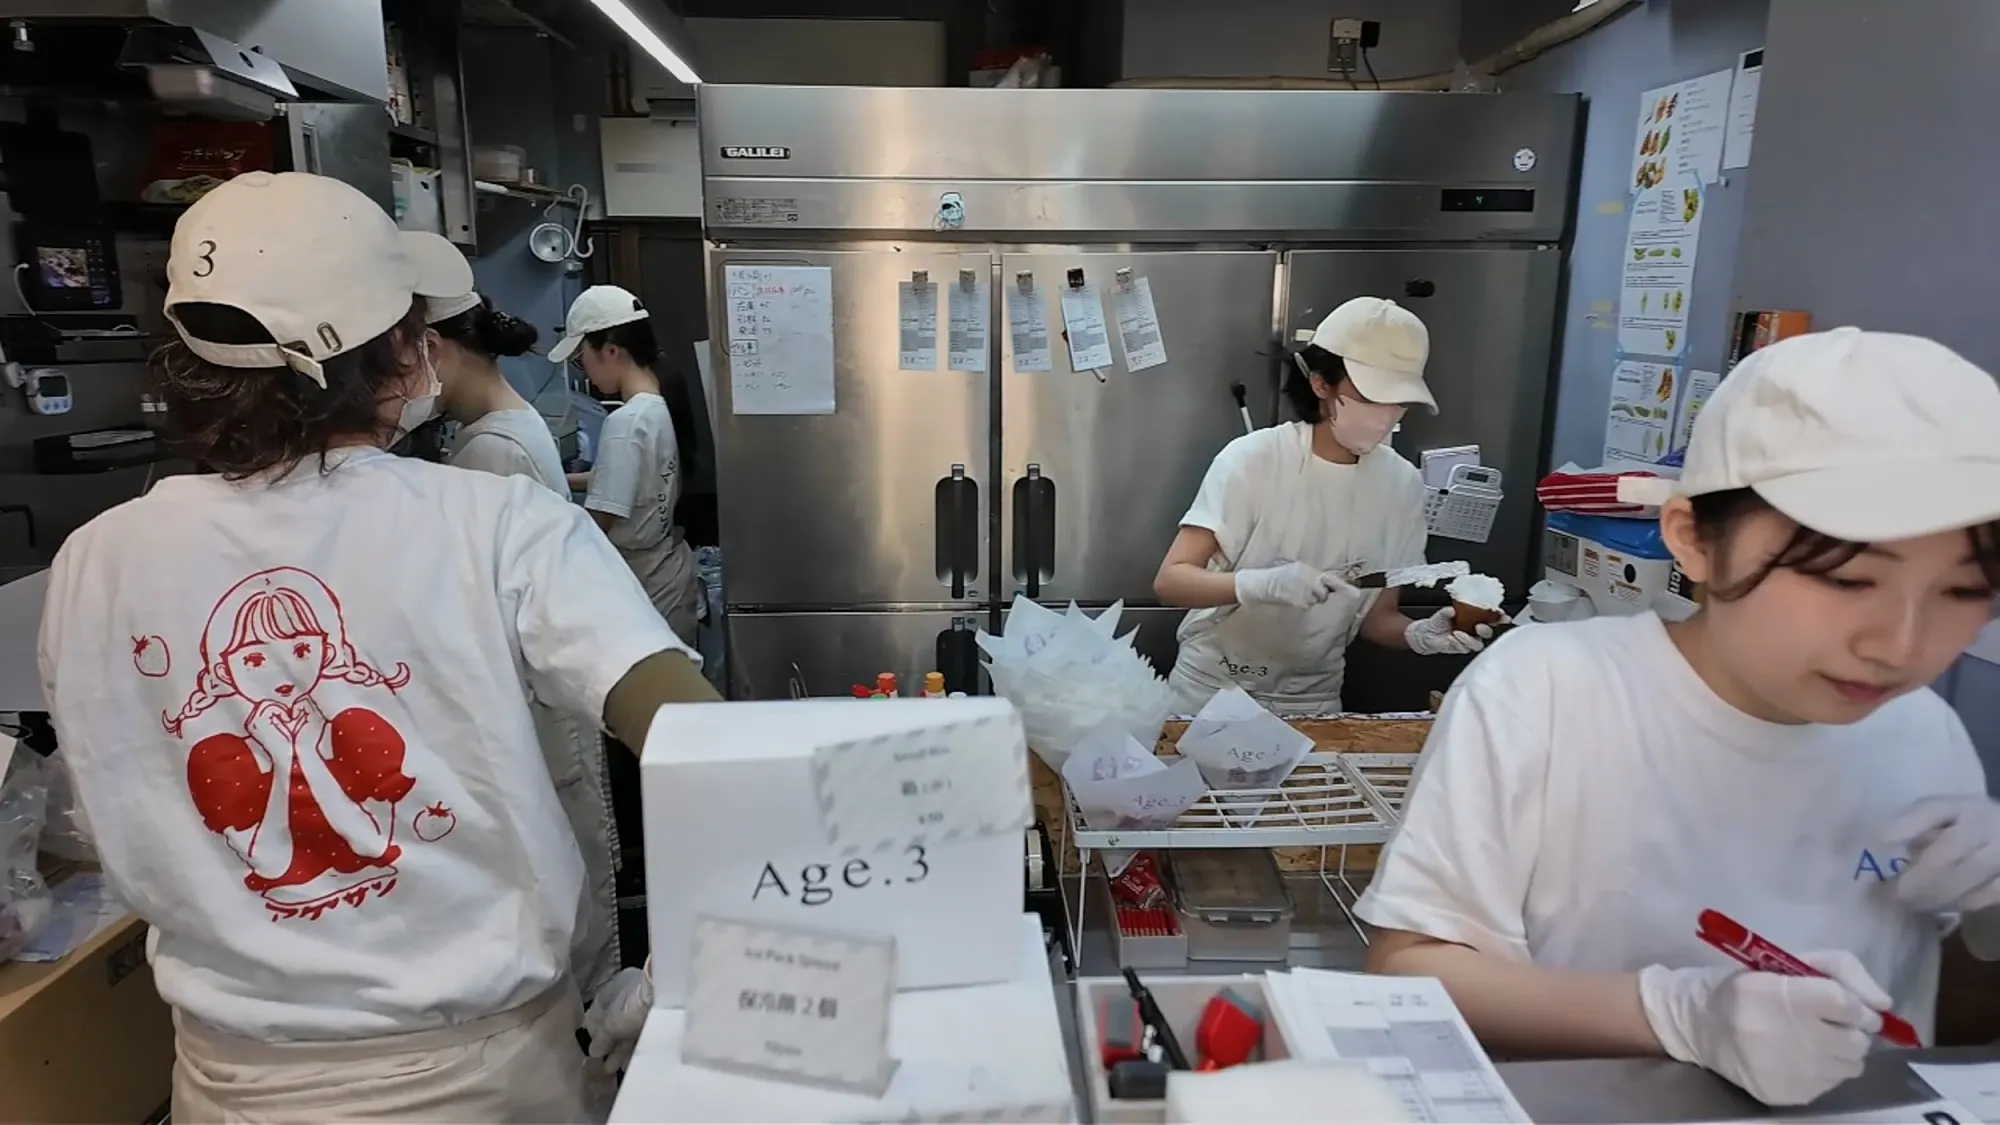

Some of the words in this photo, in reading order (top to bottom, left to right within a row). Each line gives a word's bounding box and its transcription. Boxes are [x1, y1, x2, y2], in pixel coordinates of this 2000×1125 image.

[725, 147, 785, 158] GALILEI
[192, 240, 217, 277] 3
[1219, 655, 1268, 678] Age.3
[752, 844, 930, 906] Age.3
